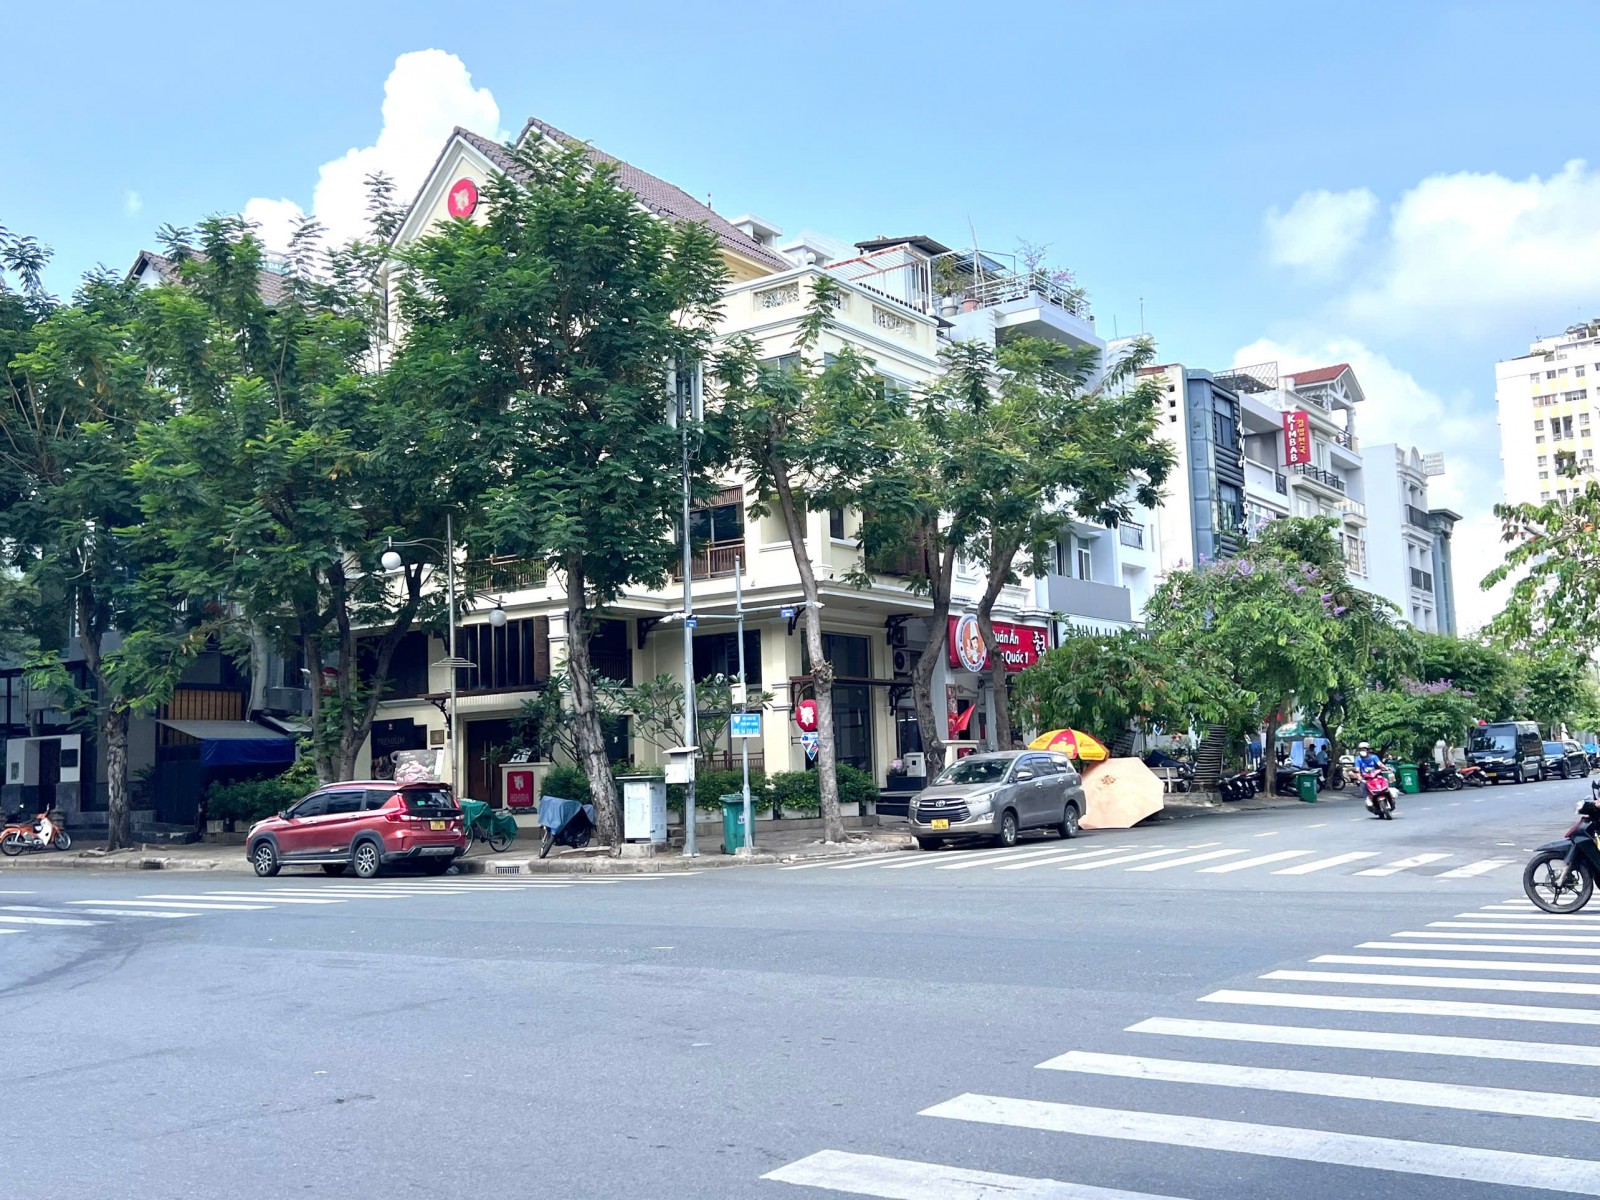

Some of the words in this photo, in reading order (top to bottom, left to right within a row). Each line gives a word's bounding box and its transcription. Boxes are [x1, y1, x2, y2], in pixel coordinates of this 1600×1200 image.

[1287, 414, 1298, 462] KIMBAB
[993, 629, 1009, 643] uán
[1009, 629, 1019, 645] Ăn
[1005, 648, 1024, 665] Quốc
[1024, 651, 1029, 663] 1
